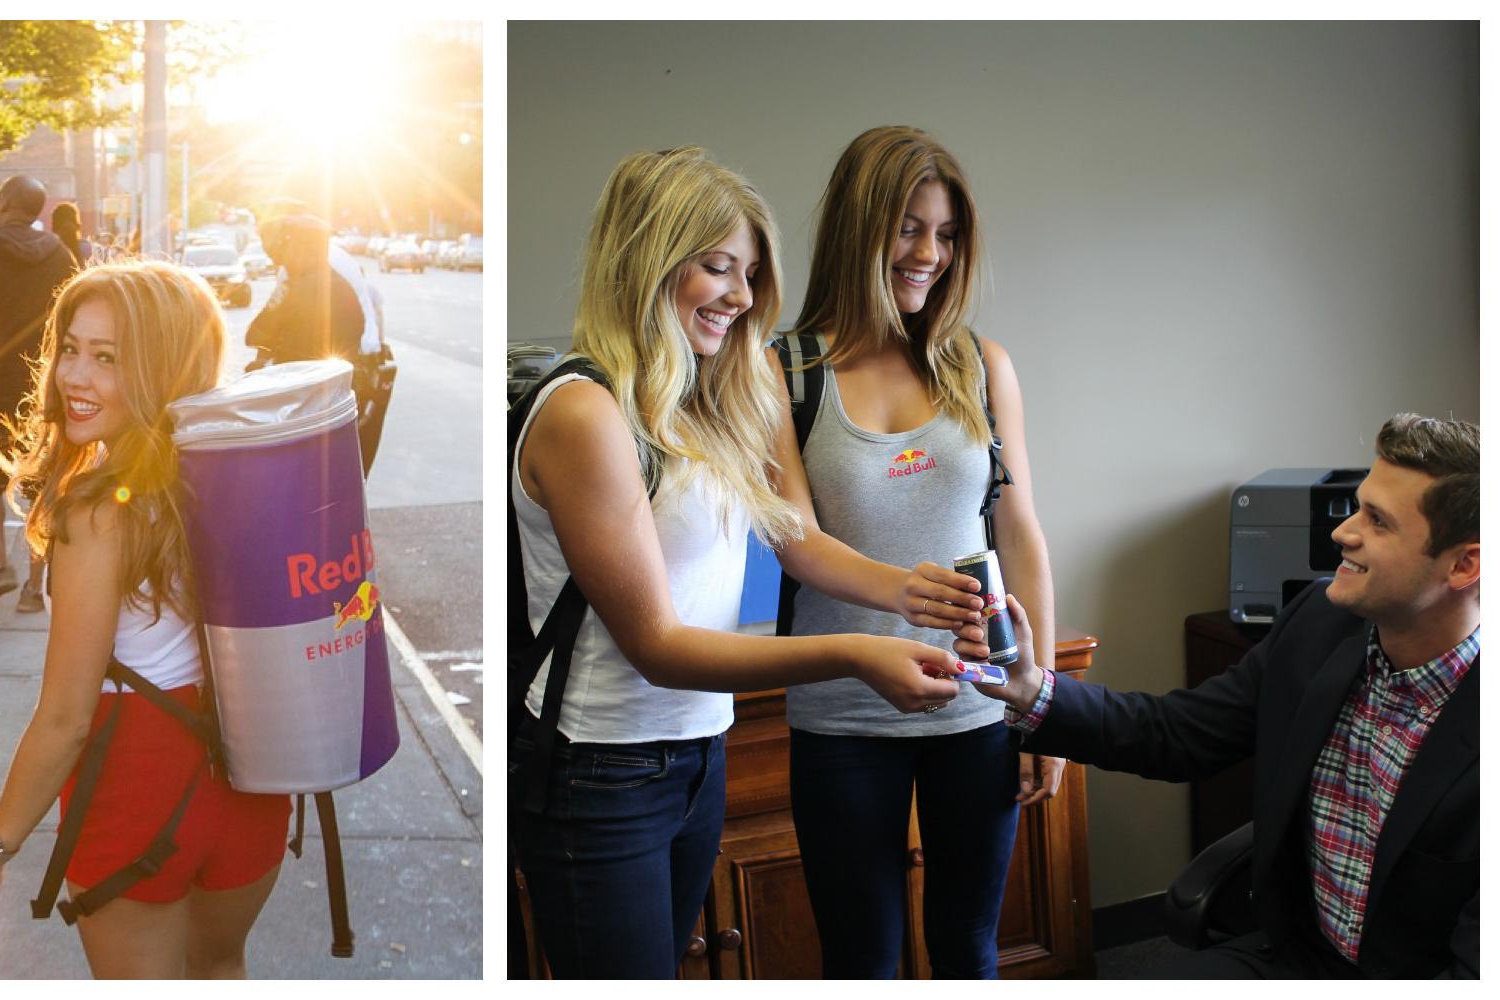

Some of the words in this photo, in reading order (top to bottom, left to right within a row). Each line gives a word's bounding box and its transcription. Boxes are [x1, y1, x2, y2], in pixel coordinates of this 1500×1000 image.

[888, 464, 912, 478] Red
[912, 457, 936, 473] Bull
[286, 533, 362, 598] Red
